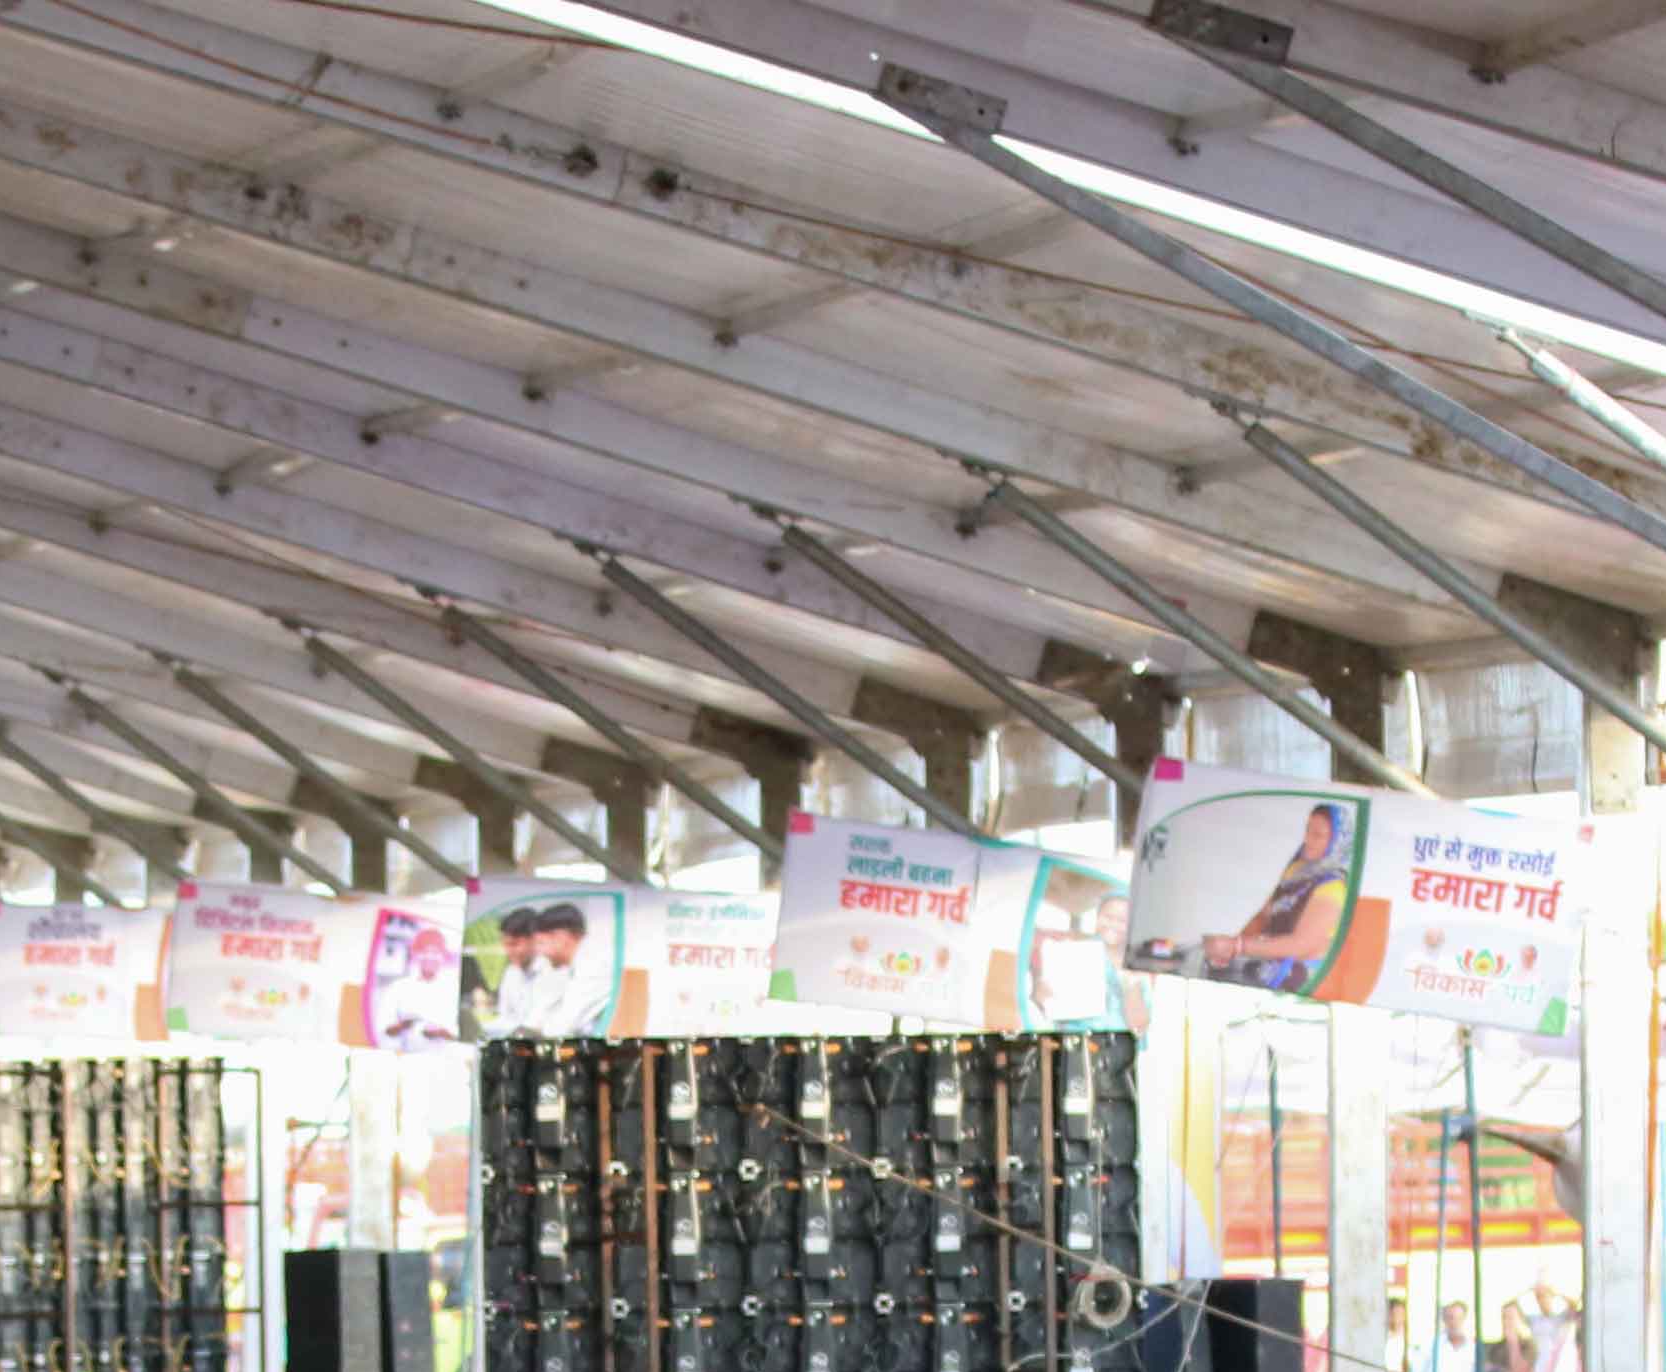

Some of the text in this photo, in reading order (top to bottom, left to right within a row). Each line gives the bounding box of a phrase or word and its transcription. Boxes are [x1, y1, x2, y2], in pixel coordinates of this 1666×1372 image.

[1445, 835, 1463, 861] से
[1507, 850, 1557, 877] रसोई
[839, 879, 973, 924] हमारा गर्व
[1411, 868, 1565, 923] हमारा गर्व
[667, 943, 735, 969] हमारा
